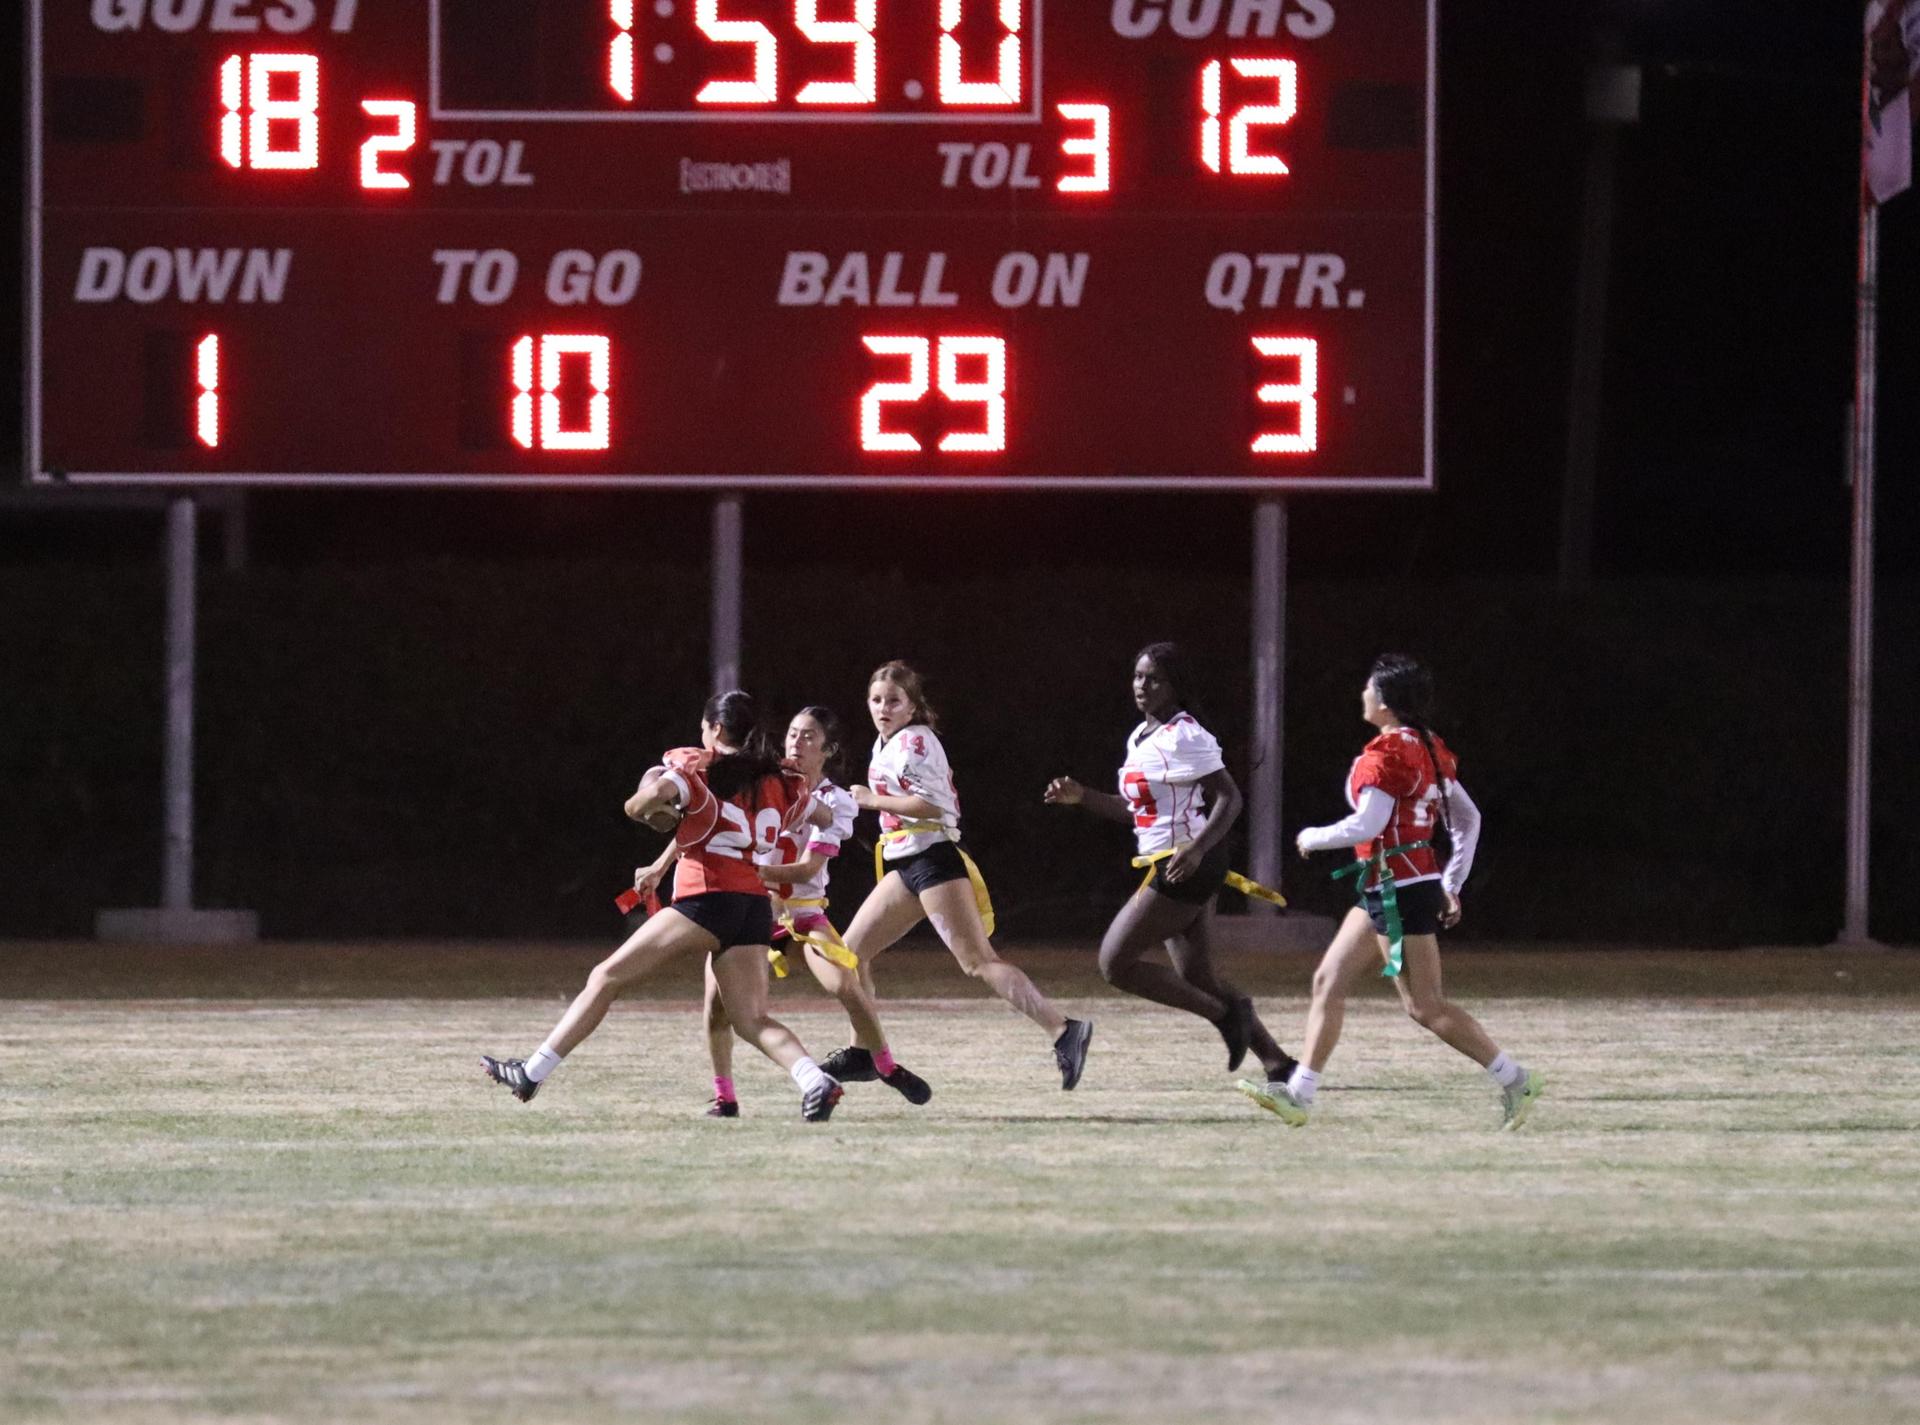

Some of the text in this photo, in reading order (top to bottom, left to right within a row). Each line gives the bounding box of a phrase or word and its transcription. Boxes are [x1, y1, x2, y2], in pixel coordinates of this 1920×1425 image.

[221, 54, 319, 169] 18
[361, 100, 415, 188] 2
[1057, 104, 1110, 192] 3
[1202, 59, 1297, 174] 12
[431, 140, 532, 185] TOL
[939, 143, 1040, 188] TOL
[75, 247, 291, 302] DOWN
[433, 249, 641, 305] TO GO
[778, 252, 1089, 307] BALL ON
[1205, 253, 1364, 312] QTR.
[198, 334, 218, 446] 1
[513, 335, 609, 450] 10
[861, 336, 1005, 451] 29
[1252, 337, 1317, 452] 3
